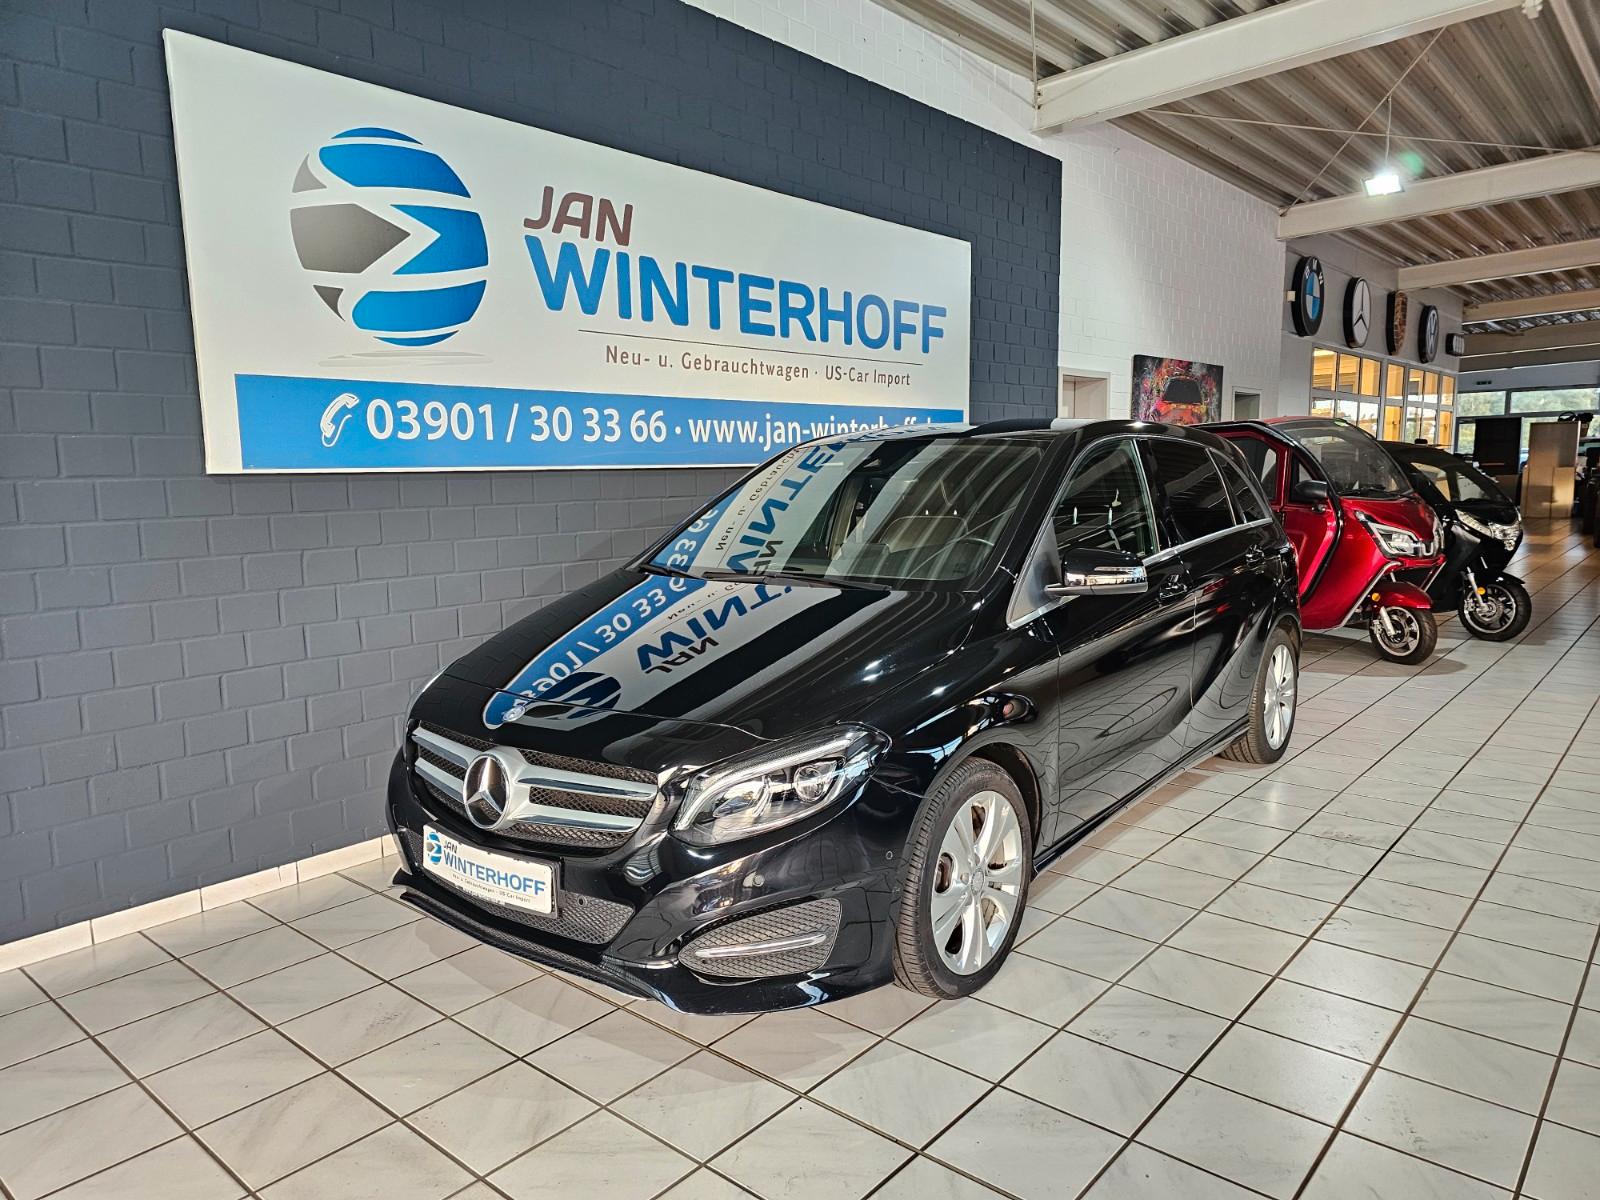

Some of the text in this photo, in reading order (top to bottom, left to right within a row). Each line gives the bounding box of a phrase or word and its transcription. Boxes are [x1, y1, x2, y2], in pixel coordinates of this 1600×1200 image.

[523, 185, 633, 246] JAN
[523, 234, 948, 354] WINTERHOFF
[605, 344, 651, 366] Neu-
[658, 353, 674, 368] u.
[681, 351, 809, 381] Gebrauchtwagen
[825, 365, 869, 383] US-Car
[873, 368, 911, 388] Import
[366, 398, 494, 441] 03901
[530, 405, 573, 442] 30
[582, 407, 621, 443] 33
[630, 409, 667, 443] 66
[443, 840, 458, 853] JAN
[443, 851, 546, 896] WINTERHOFF
